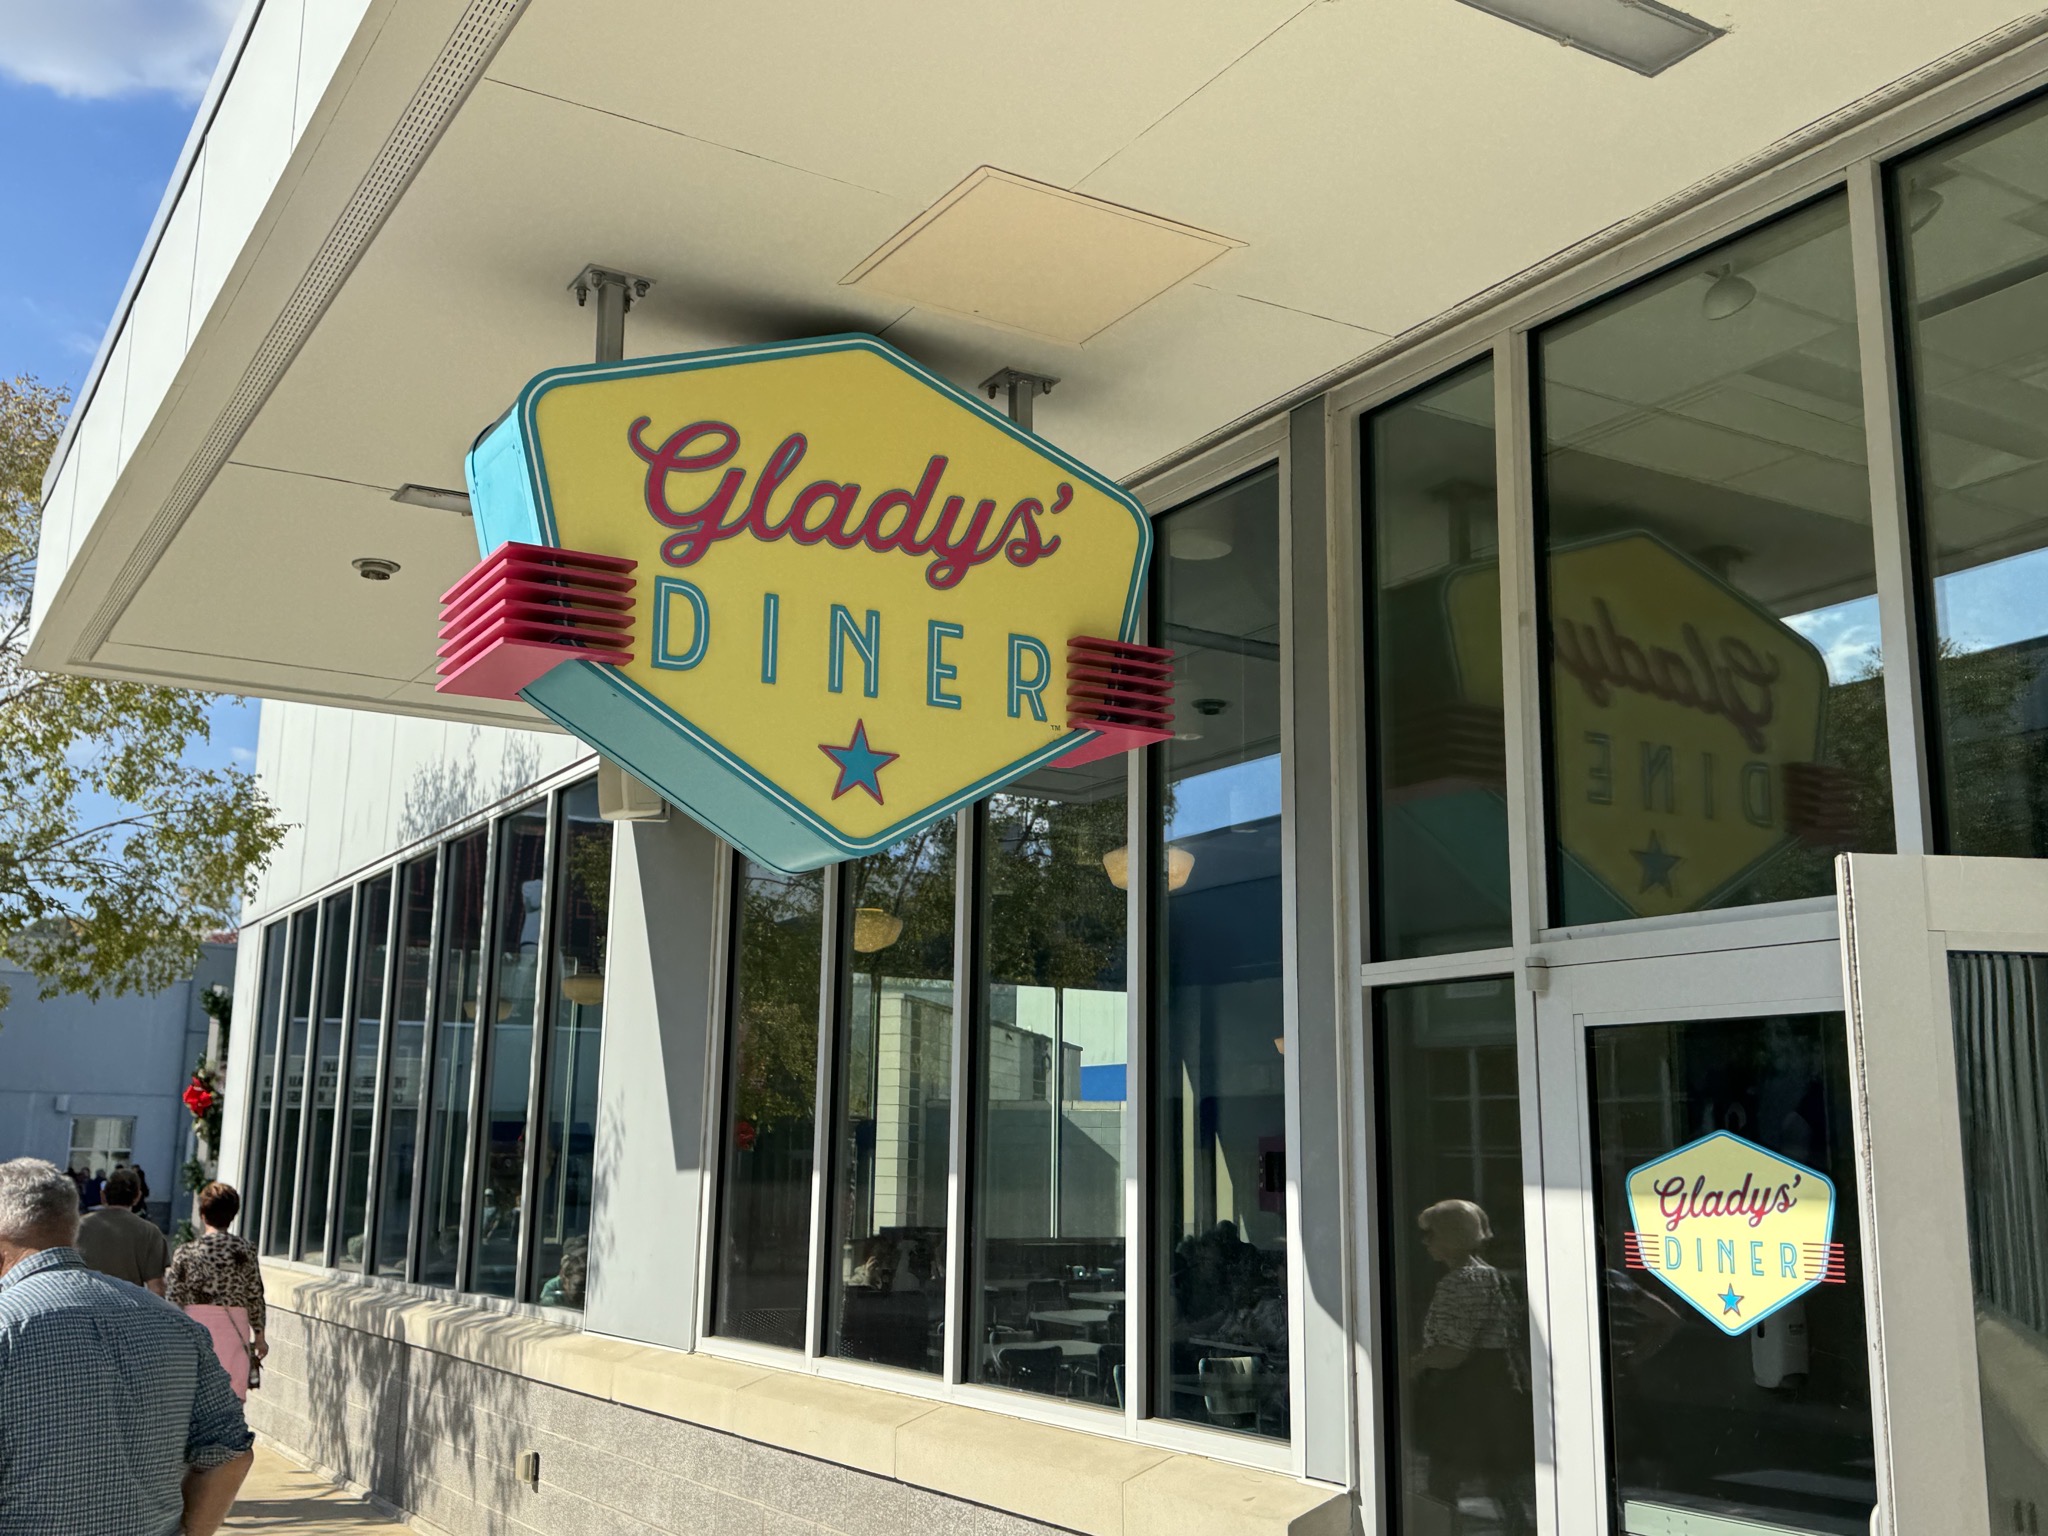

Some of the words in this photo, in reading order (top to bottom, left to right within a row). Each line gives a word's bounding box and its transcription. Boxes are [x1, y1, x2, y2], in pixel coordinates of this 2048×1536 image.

[628, 416, 1073, 589] Gladys'
[651, 576, 1049, 722] DINER
[1654, 1173, 1801, 1231] Gladys'
[1665, 1236, 1797, 1278] DINER
